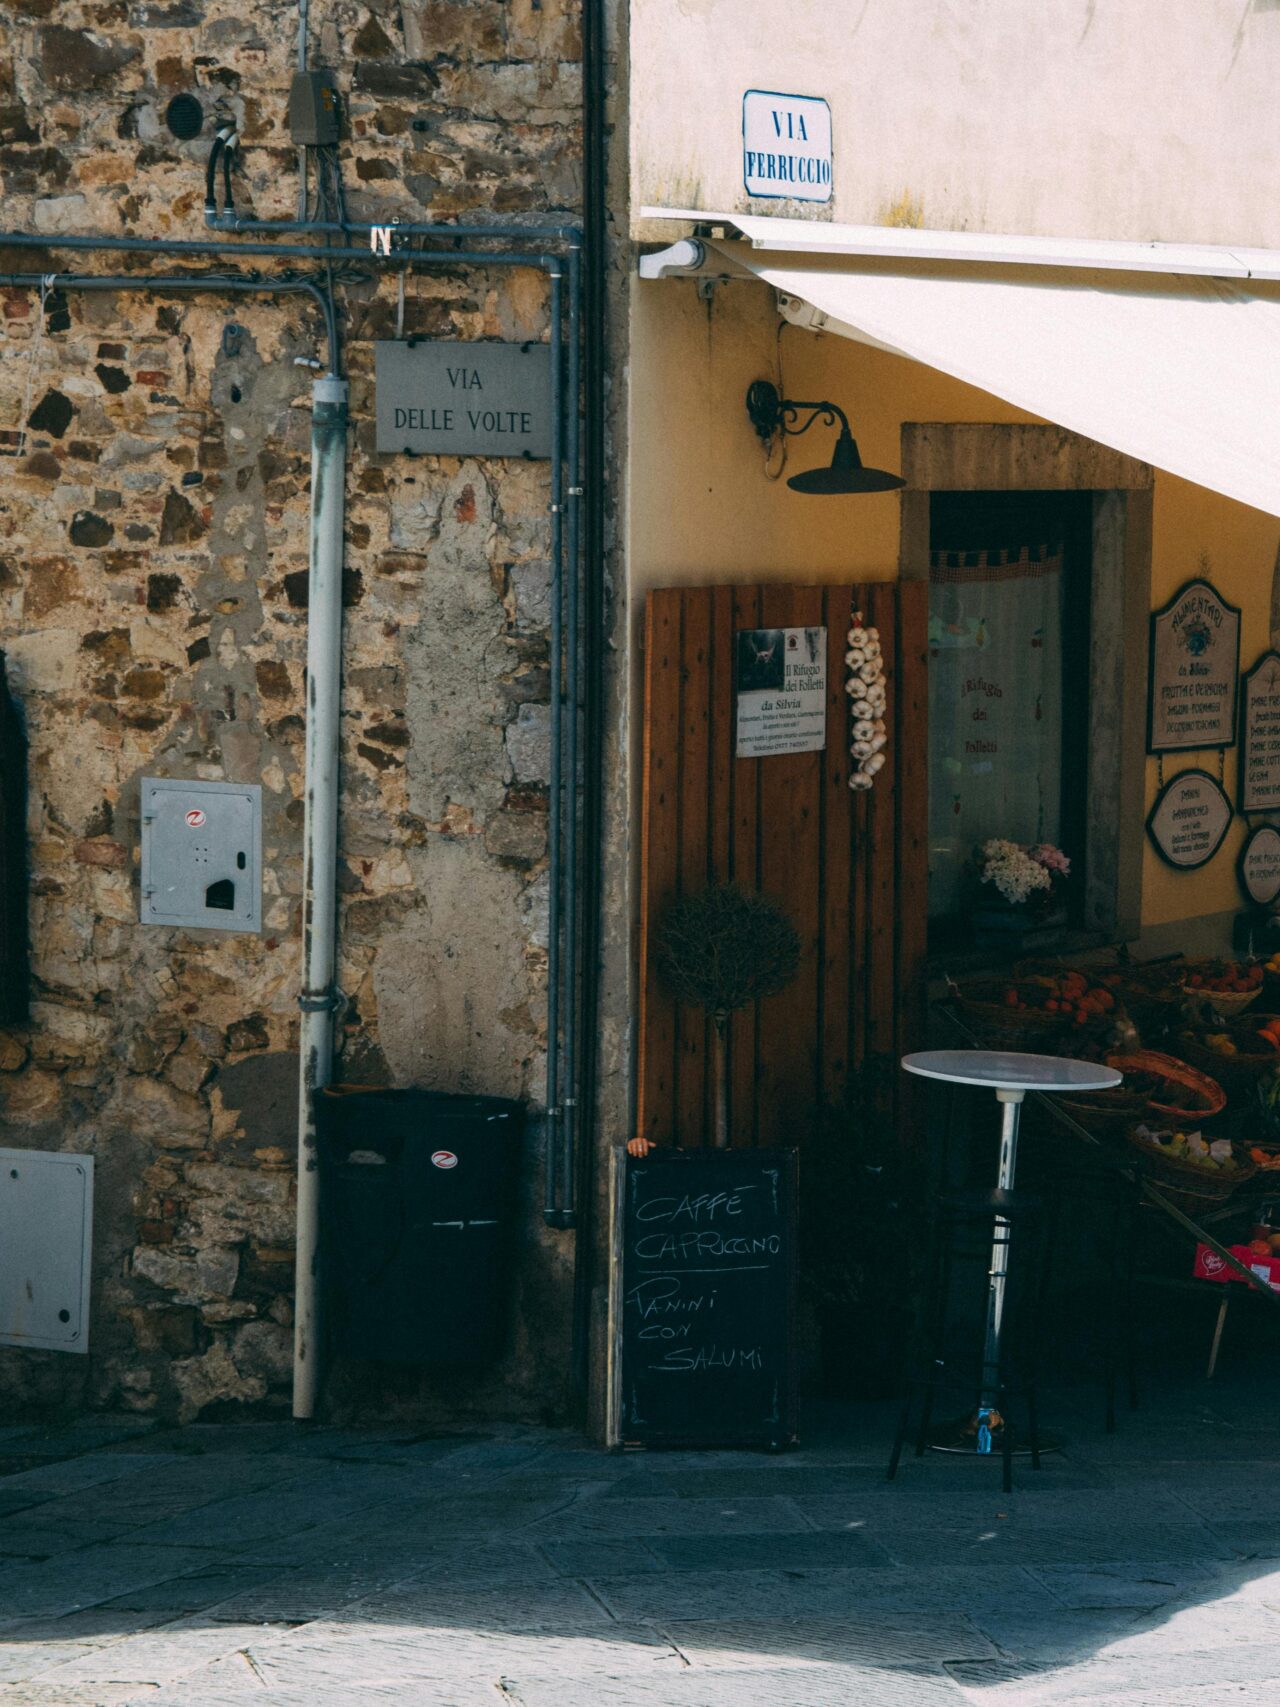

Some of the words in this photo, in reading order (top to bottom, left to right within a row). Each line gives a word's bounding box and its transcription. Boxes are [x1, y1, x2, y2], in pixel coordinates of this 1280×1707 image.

[772, 110, 808, 141] VIA
[746, 151, 830, 185] FERRUCCIO
[446, 368, 483, 390] VIA
[394, 408, 454, 431] DELLE
[466, 410, 532, 434] VOLTE
[785, 664, 791, 677] Il
[793, 663, 820, 678] Rifugio
[785, 679, 797, 692] dei
[799, 678, 824, 691] Folletti
[761, 701, 773, 711] da
[776, 698, 801, 710] Silvia
